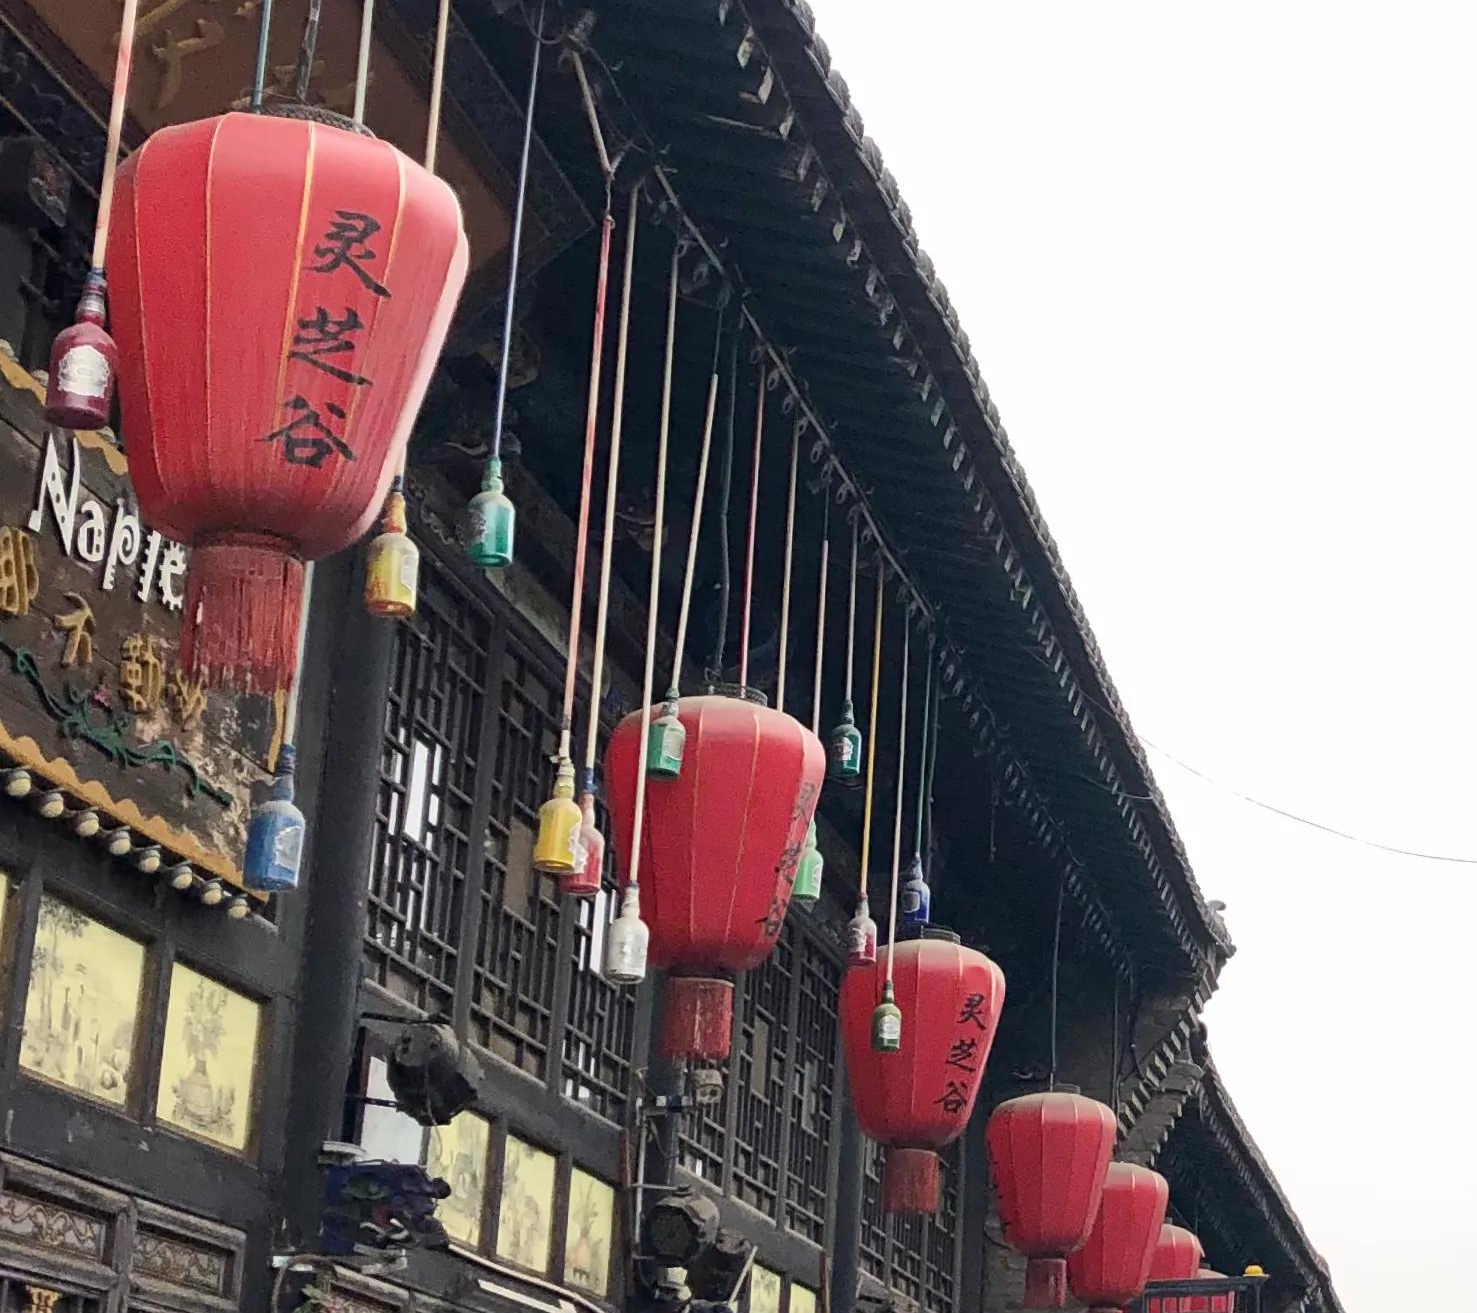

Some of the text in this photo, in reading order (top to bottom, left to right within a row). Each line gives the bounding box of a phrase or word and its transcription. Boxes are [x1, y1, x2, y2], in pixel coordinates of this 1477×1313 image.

[256, 209, 392, 471] 灵芝谷
[28, 432, 190, 612] Naple
[934, 993, 988, 1115] 灵芝谷
